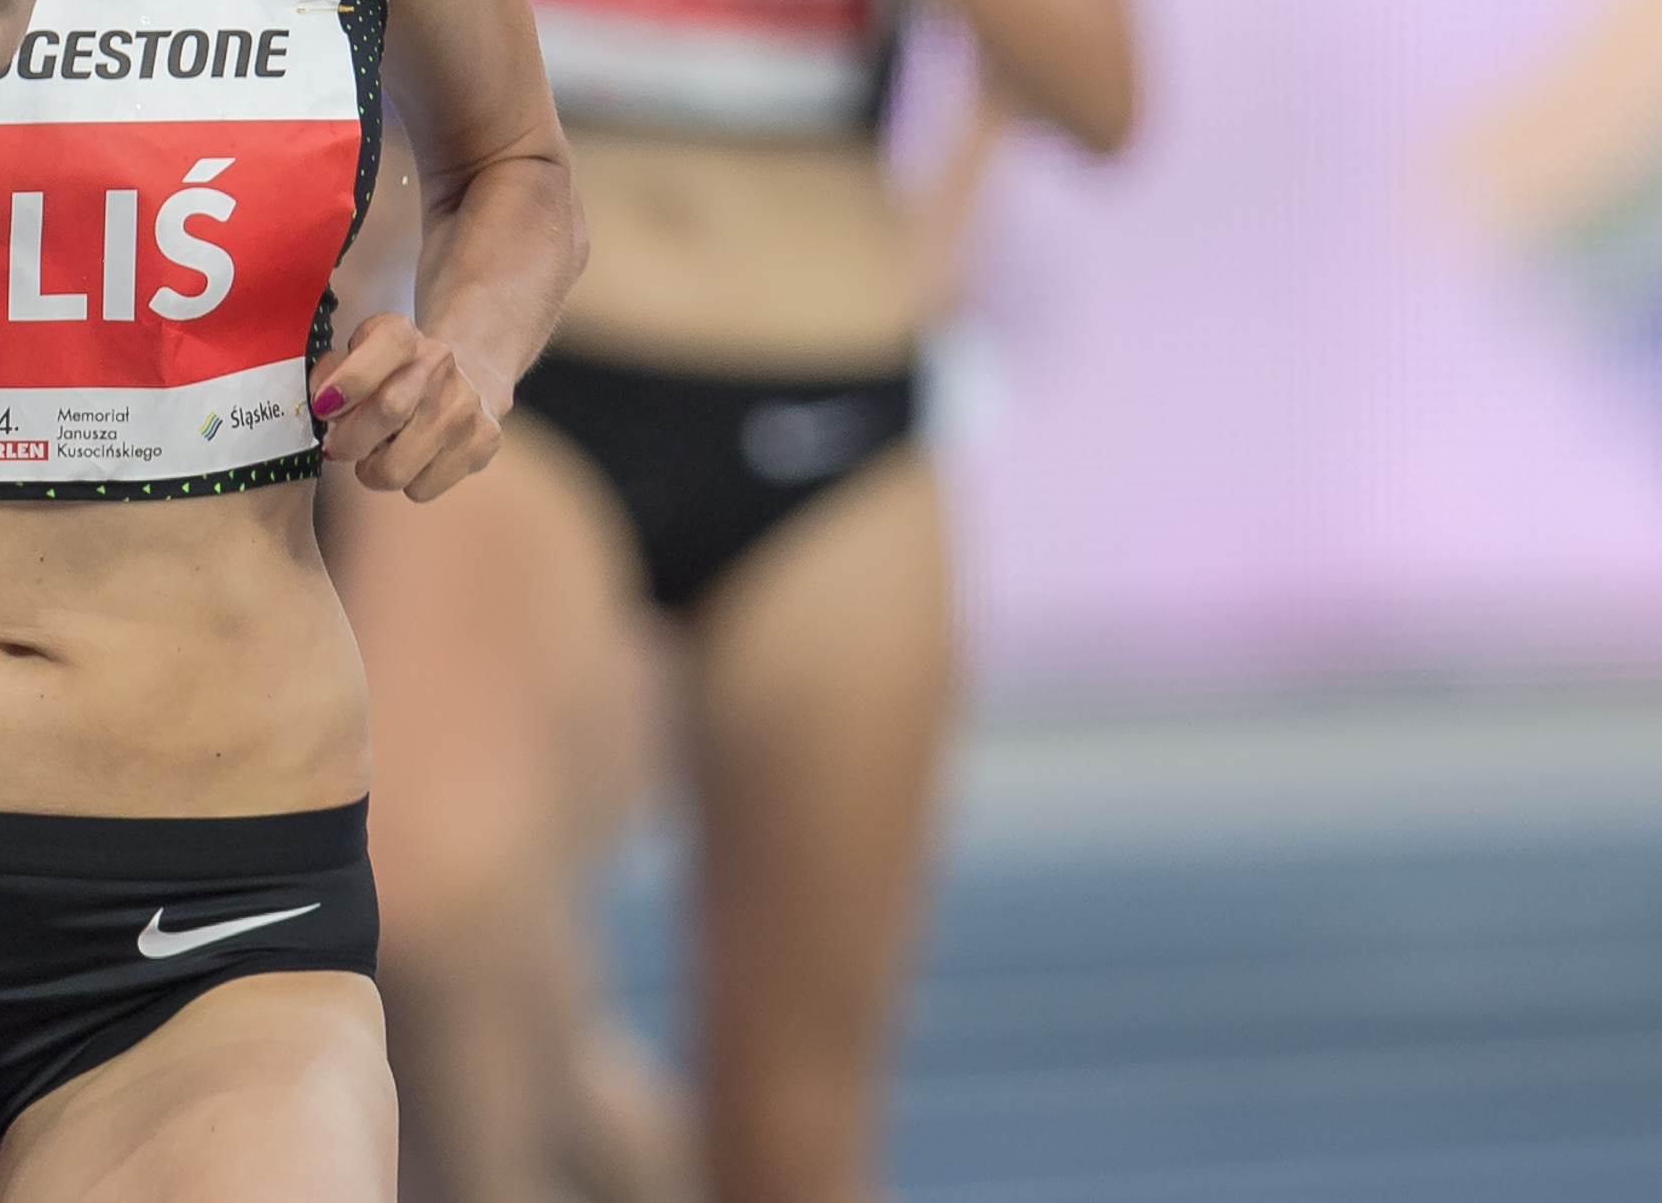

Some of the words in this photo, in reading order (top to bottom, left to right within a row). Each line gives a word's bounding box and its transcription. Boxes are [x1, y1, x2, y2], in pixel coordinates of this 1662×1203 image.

[56, 405, 130, 423] Memoriał
[230, 400, 285, 430] Śląskie.
[56, 425, 118, 441] Janusza
[56, 441, 163, 462] Kusocińskiego
